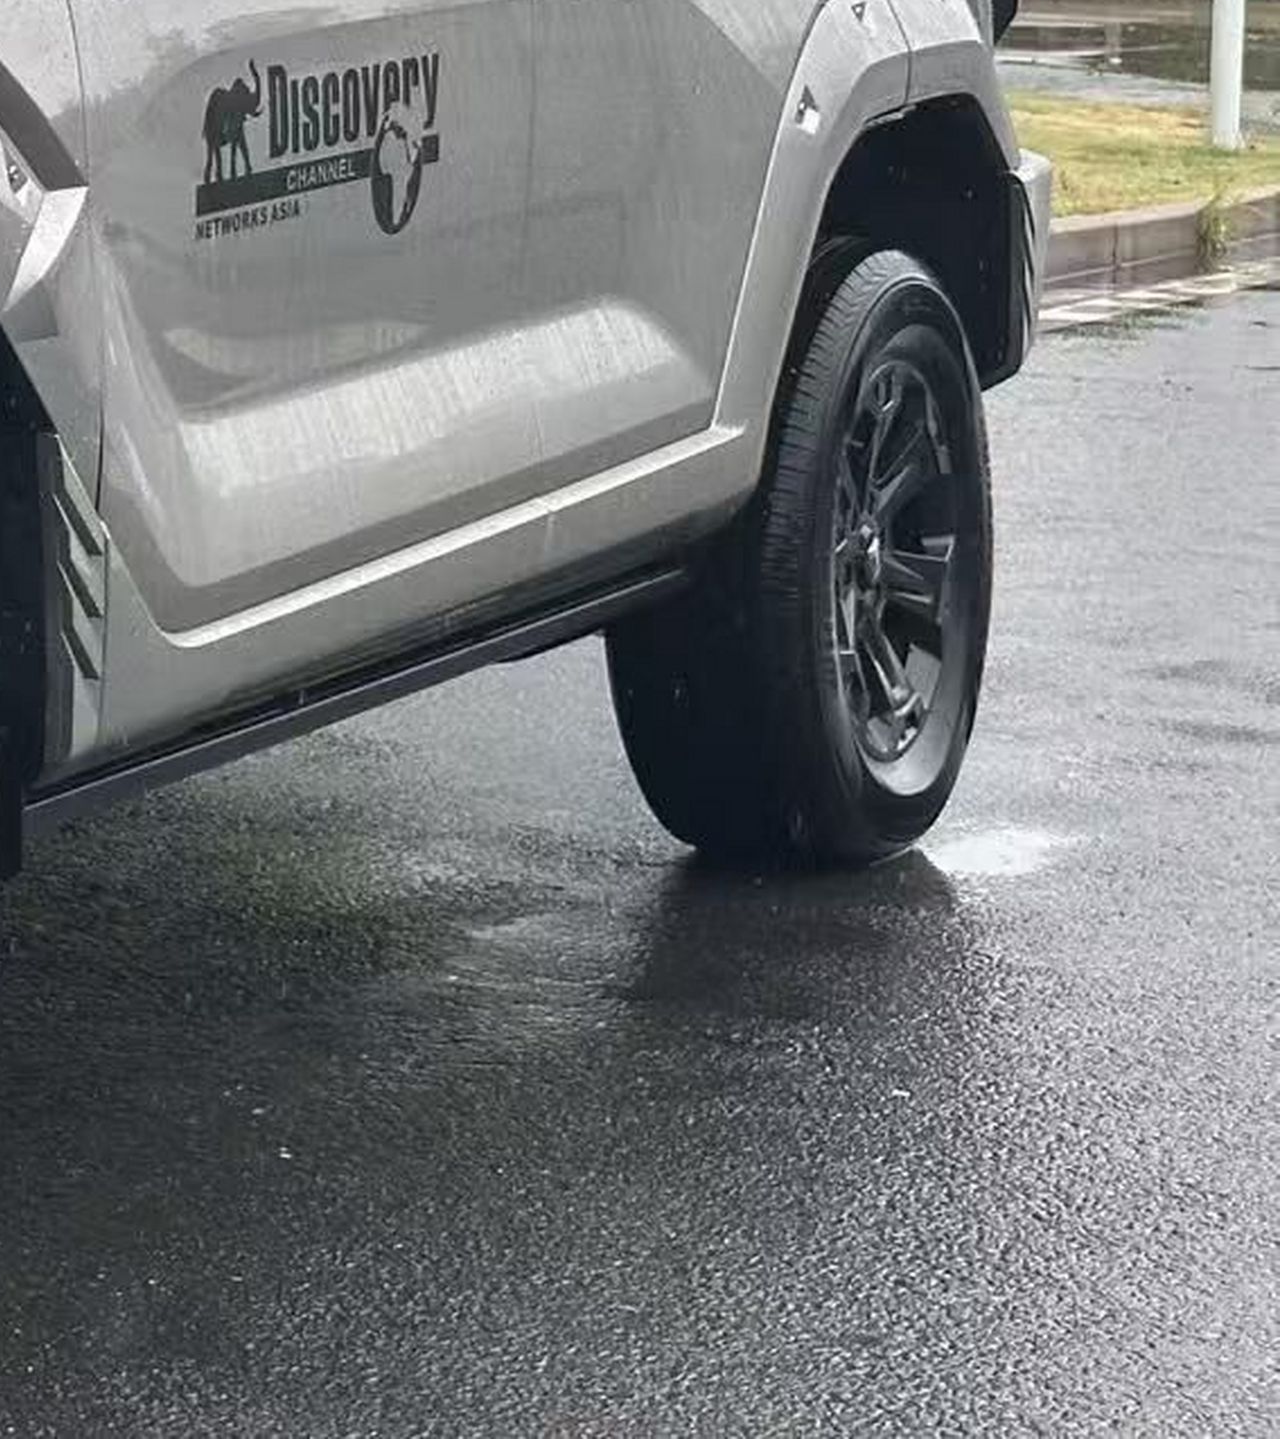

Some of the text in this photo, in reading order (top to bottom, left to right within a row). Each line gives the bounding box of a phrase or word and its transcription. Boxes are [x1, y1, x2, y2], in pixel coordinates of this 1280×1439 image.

[287, 158, 356, 191] CHANNEL
[195, 200, 301, 240] NETWORKS ASIA
